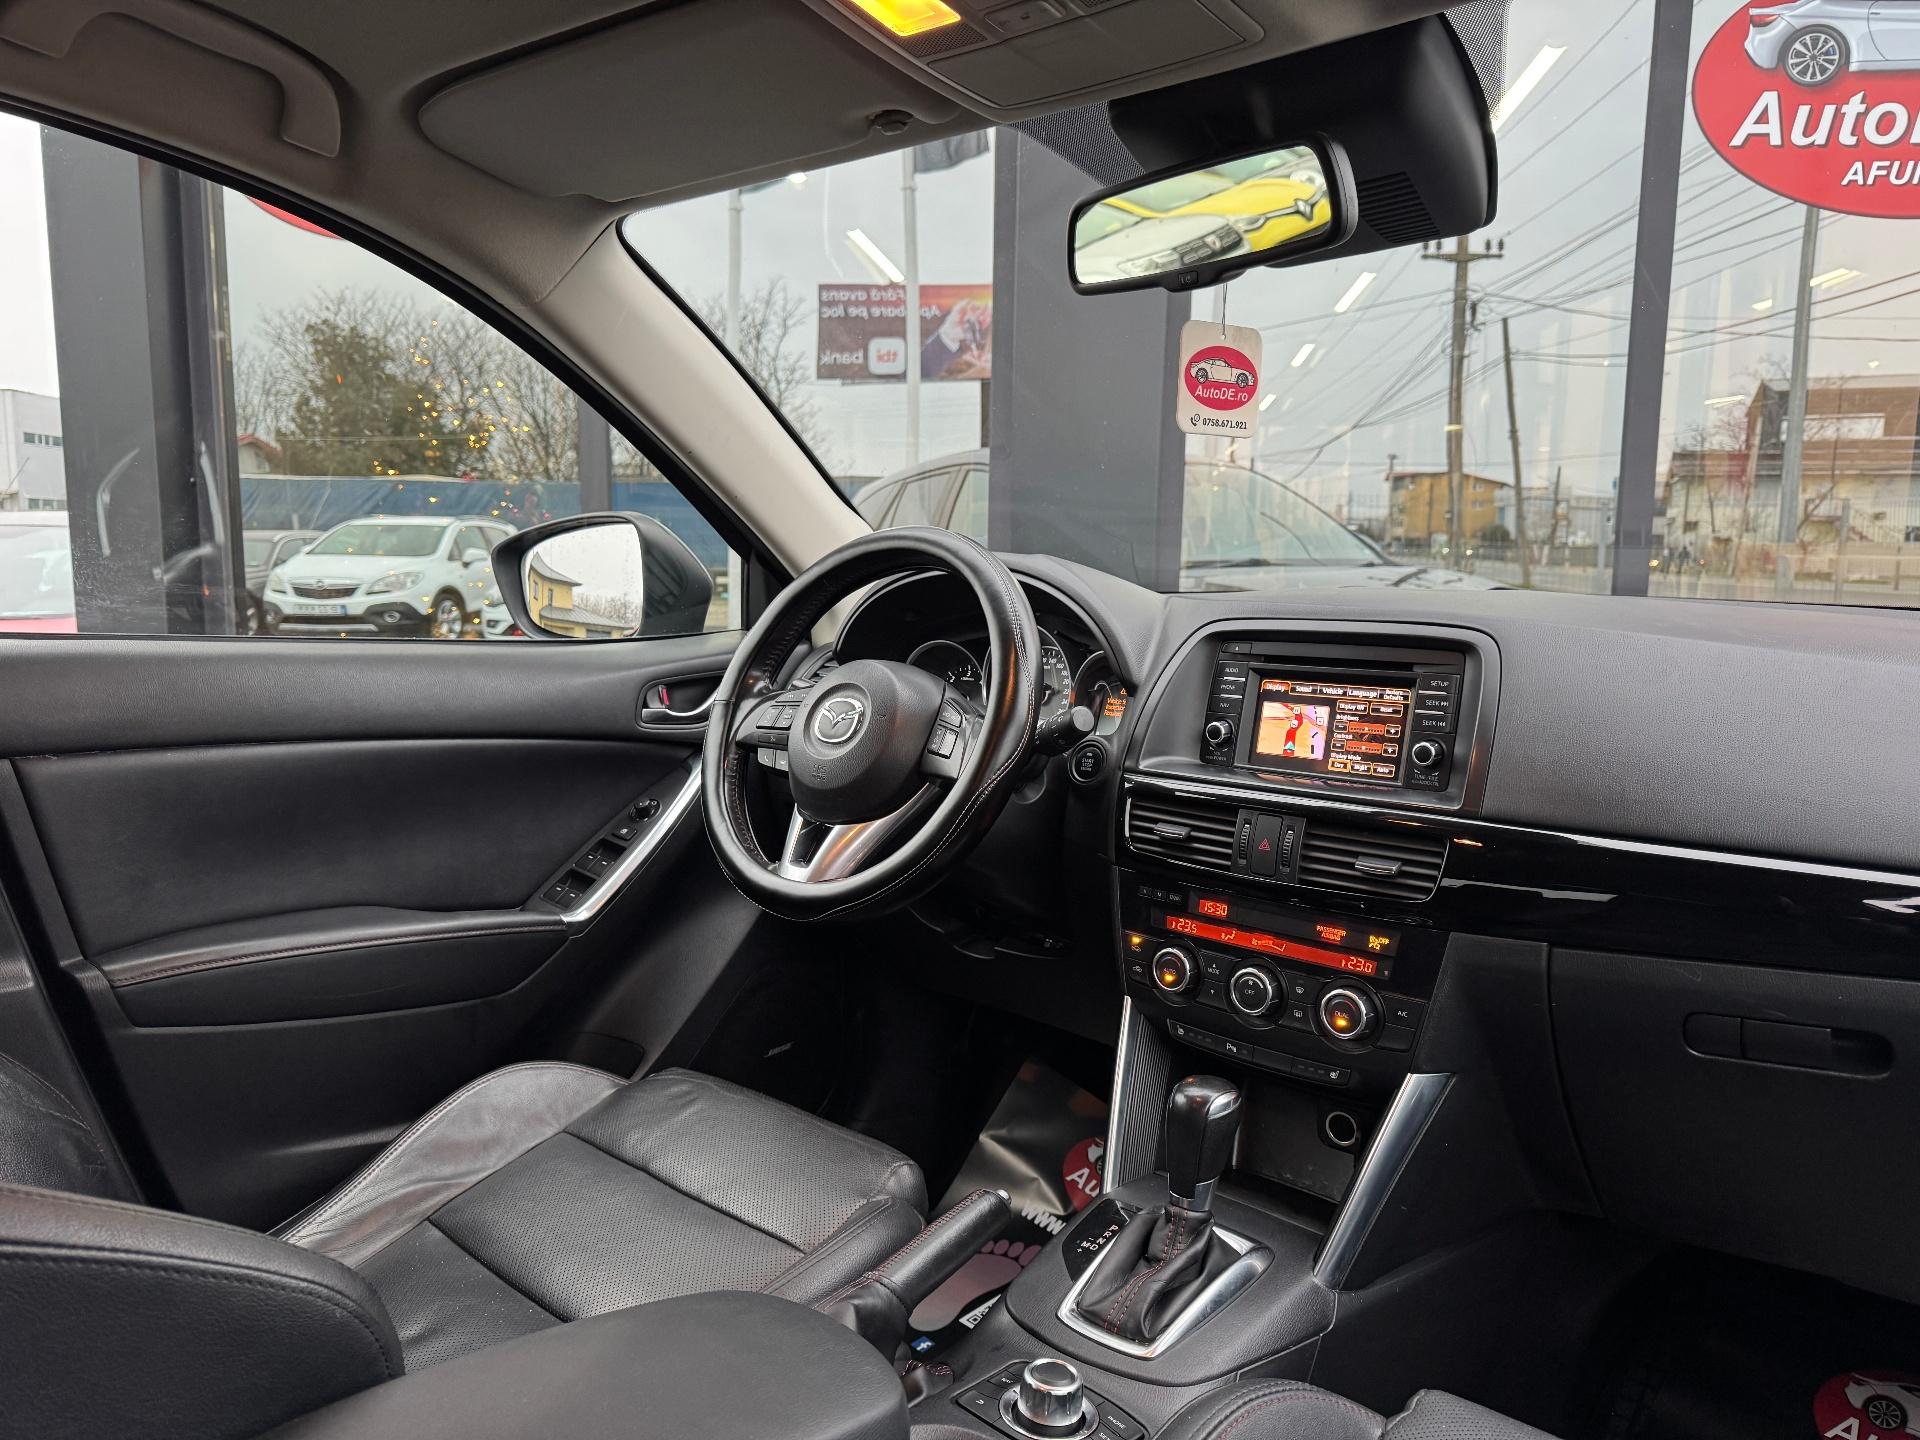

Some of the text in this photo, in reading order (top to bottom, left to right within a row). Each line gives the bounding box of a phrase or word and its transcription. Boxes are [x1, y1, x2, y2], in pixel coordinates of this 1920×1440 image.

[1729, 91, 1920, 146] Auto
[1195, 385, 1248, 402] AutoDE.ro
[1202, 417, 1247, 430] 0758.671.921
[1266, 683, 1286, 692] Display
[1296, 685, 1312, 693] Sound
[1323, 687, 1343, 695] Vehicle
[1348, 689, 1377, 699] Language
[1204, 902, 1228, 916] 15:30
[1107, 1415, 1126, 1430] PHONE
